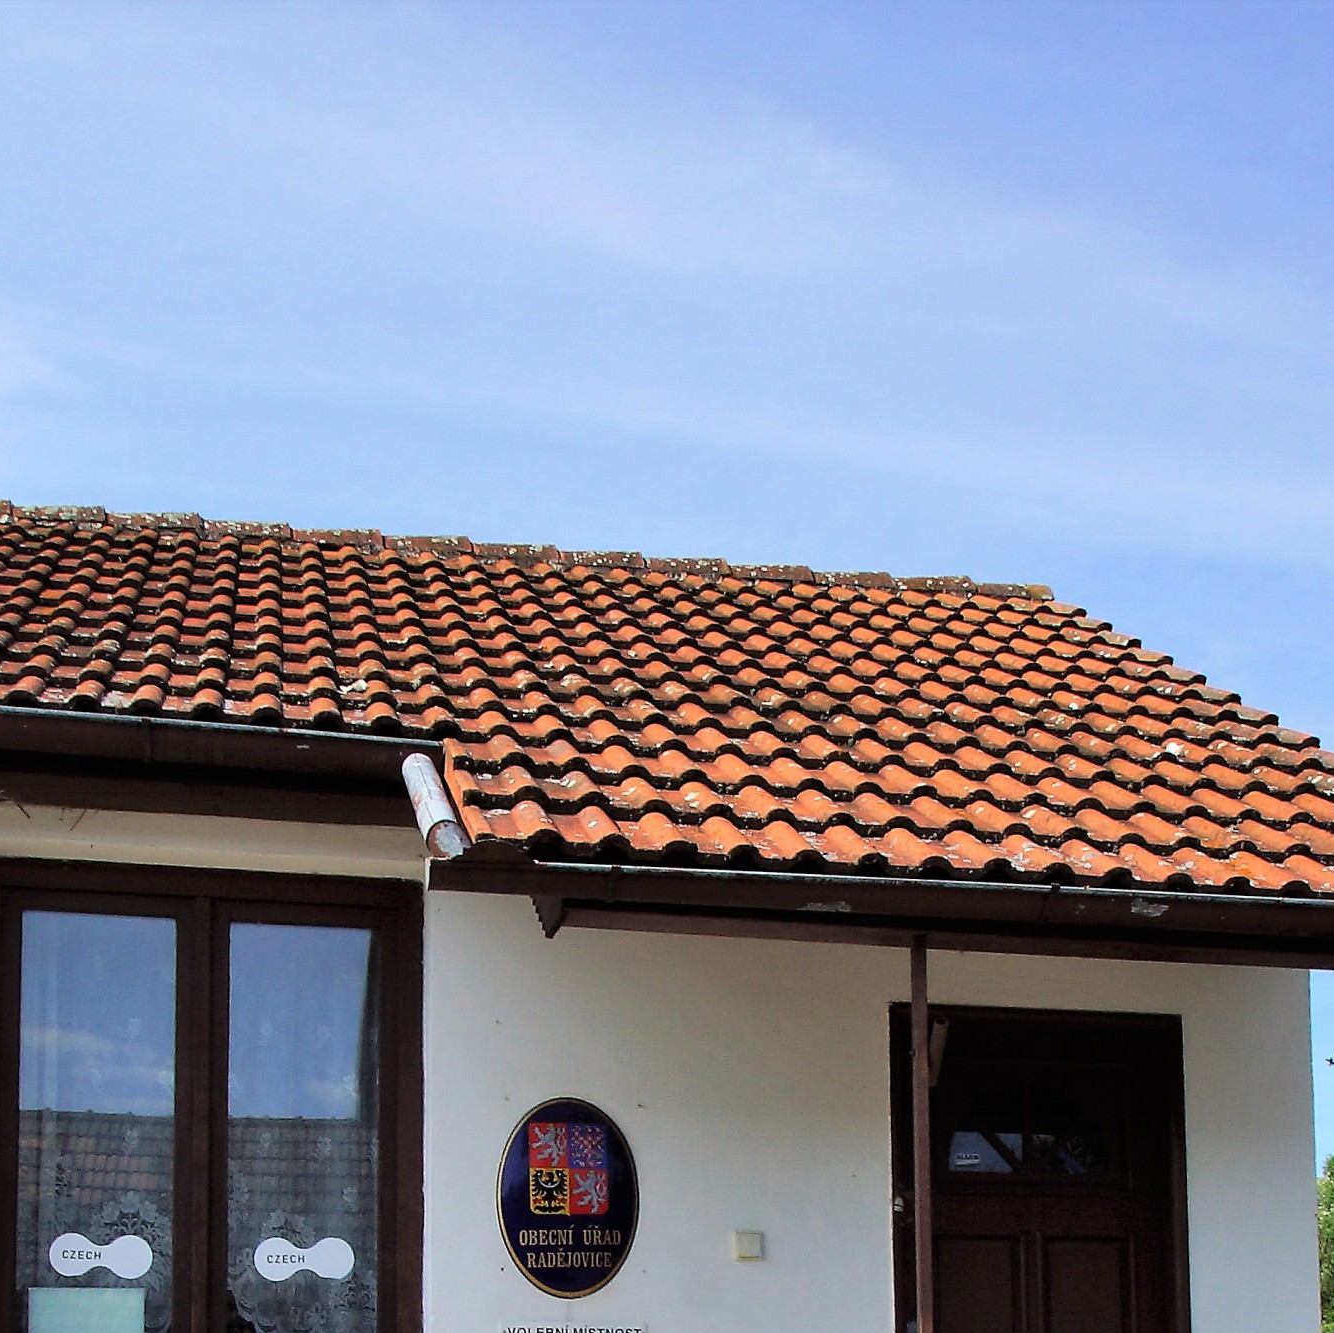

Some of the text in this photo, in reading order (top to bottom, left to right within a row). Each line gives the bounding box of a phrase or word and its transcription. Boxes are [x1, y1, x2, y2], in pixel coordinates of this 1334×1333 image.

[519, 1225, 621, 1246] OBECNÍ ÚŘAD
[62, 1250, 101, 1260] CZECH
[266, 1254, 305, 1264] CZECH
[527, 1248, 612, 1268] RADĚJOVICE
